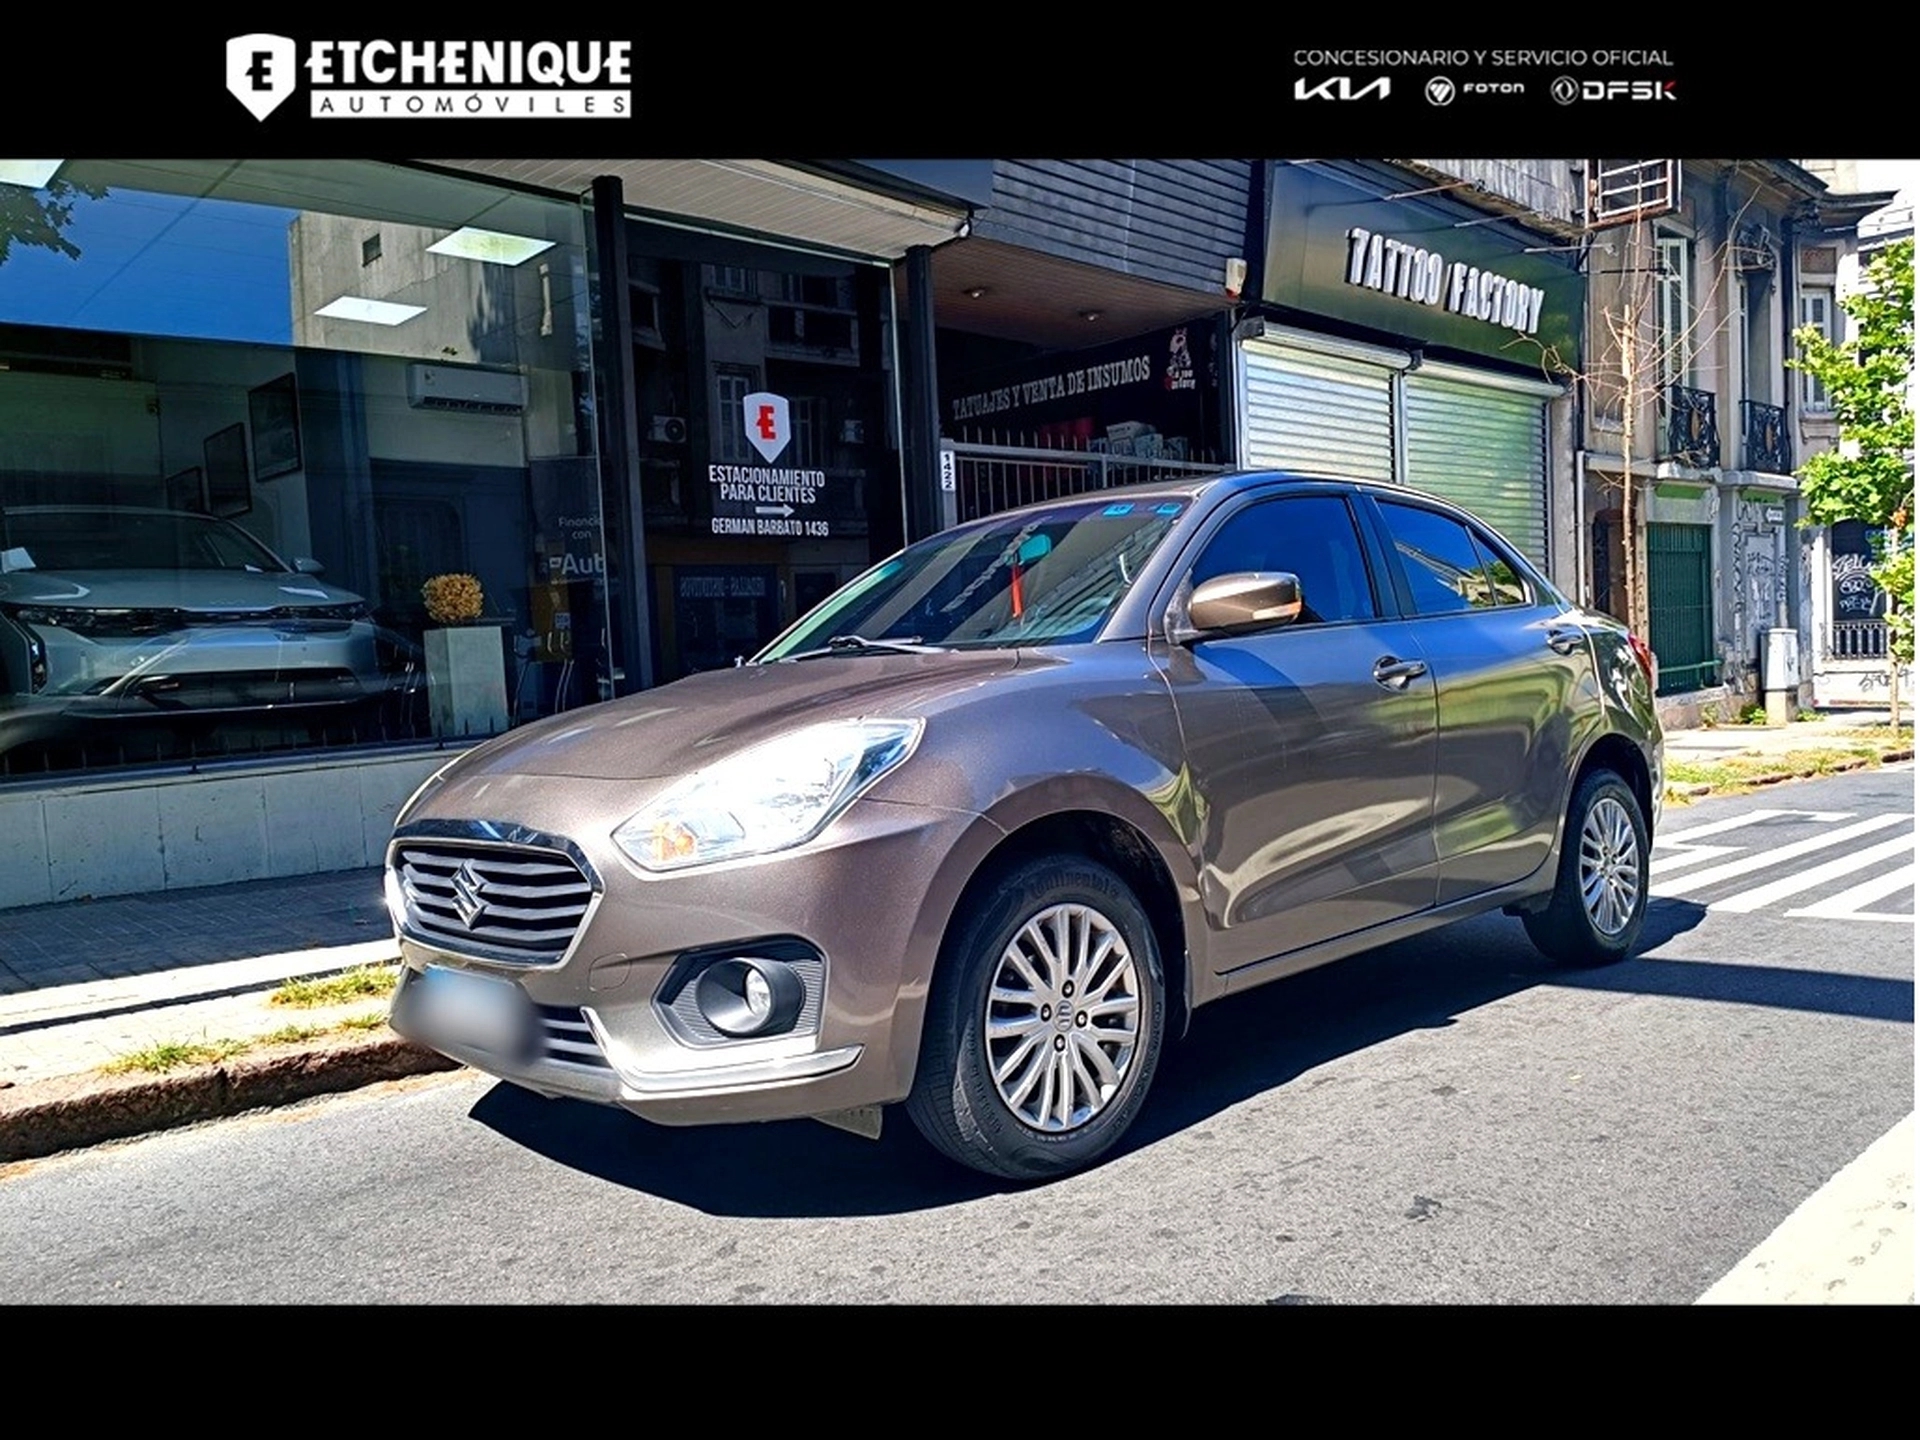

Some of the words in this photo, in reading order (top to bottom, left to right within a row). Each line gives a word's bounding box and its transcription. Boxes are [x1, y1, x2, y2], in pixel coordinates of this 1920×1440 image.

[1346, 227, 1443, 305] TATTOO
[1447, 262, 1545, 334] FACTORY
[952, 387, 1011, 421] TATUAJES
[1012, 384, 1022, 408] Y
[1022, 374, 1066, 405] VENTA
[1067, 369, 1085, 396] DE
[1086, 355, 1151, 392] INSUMOS
[708, 464, 826, 489] ESTACIONAMIENTO
[943, 453, 953, 489] 1422
[720, 483, 756, 501] PARA
[757, 484, 816, 504] CLIENTES
[571, 530, 593, 541] con
[711, 517, 755, 535] GERMAN
[756, 519, 803, 536] BARBATO
[804, 520, 830, 537] 1436
